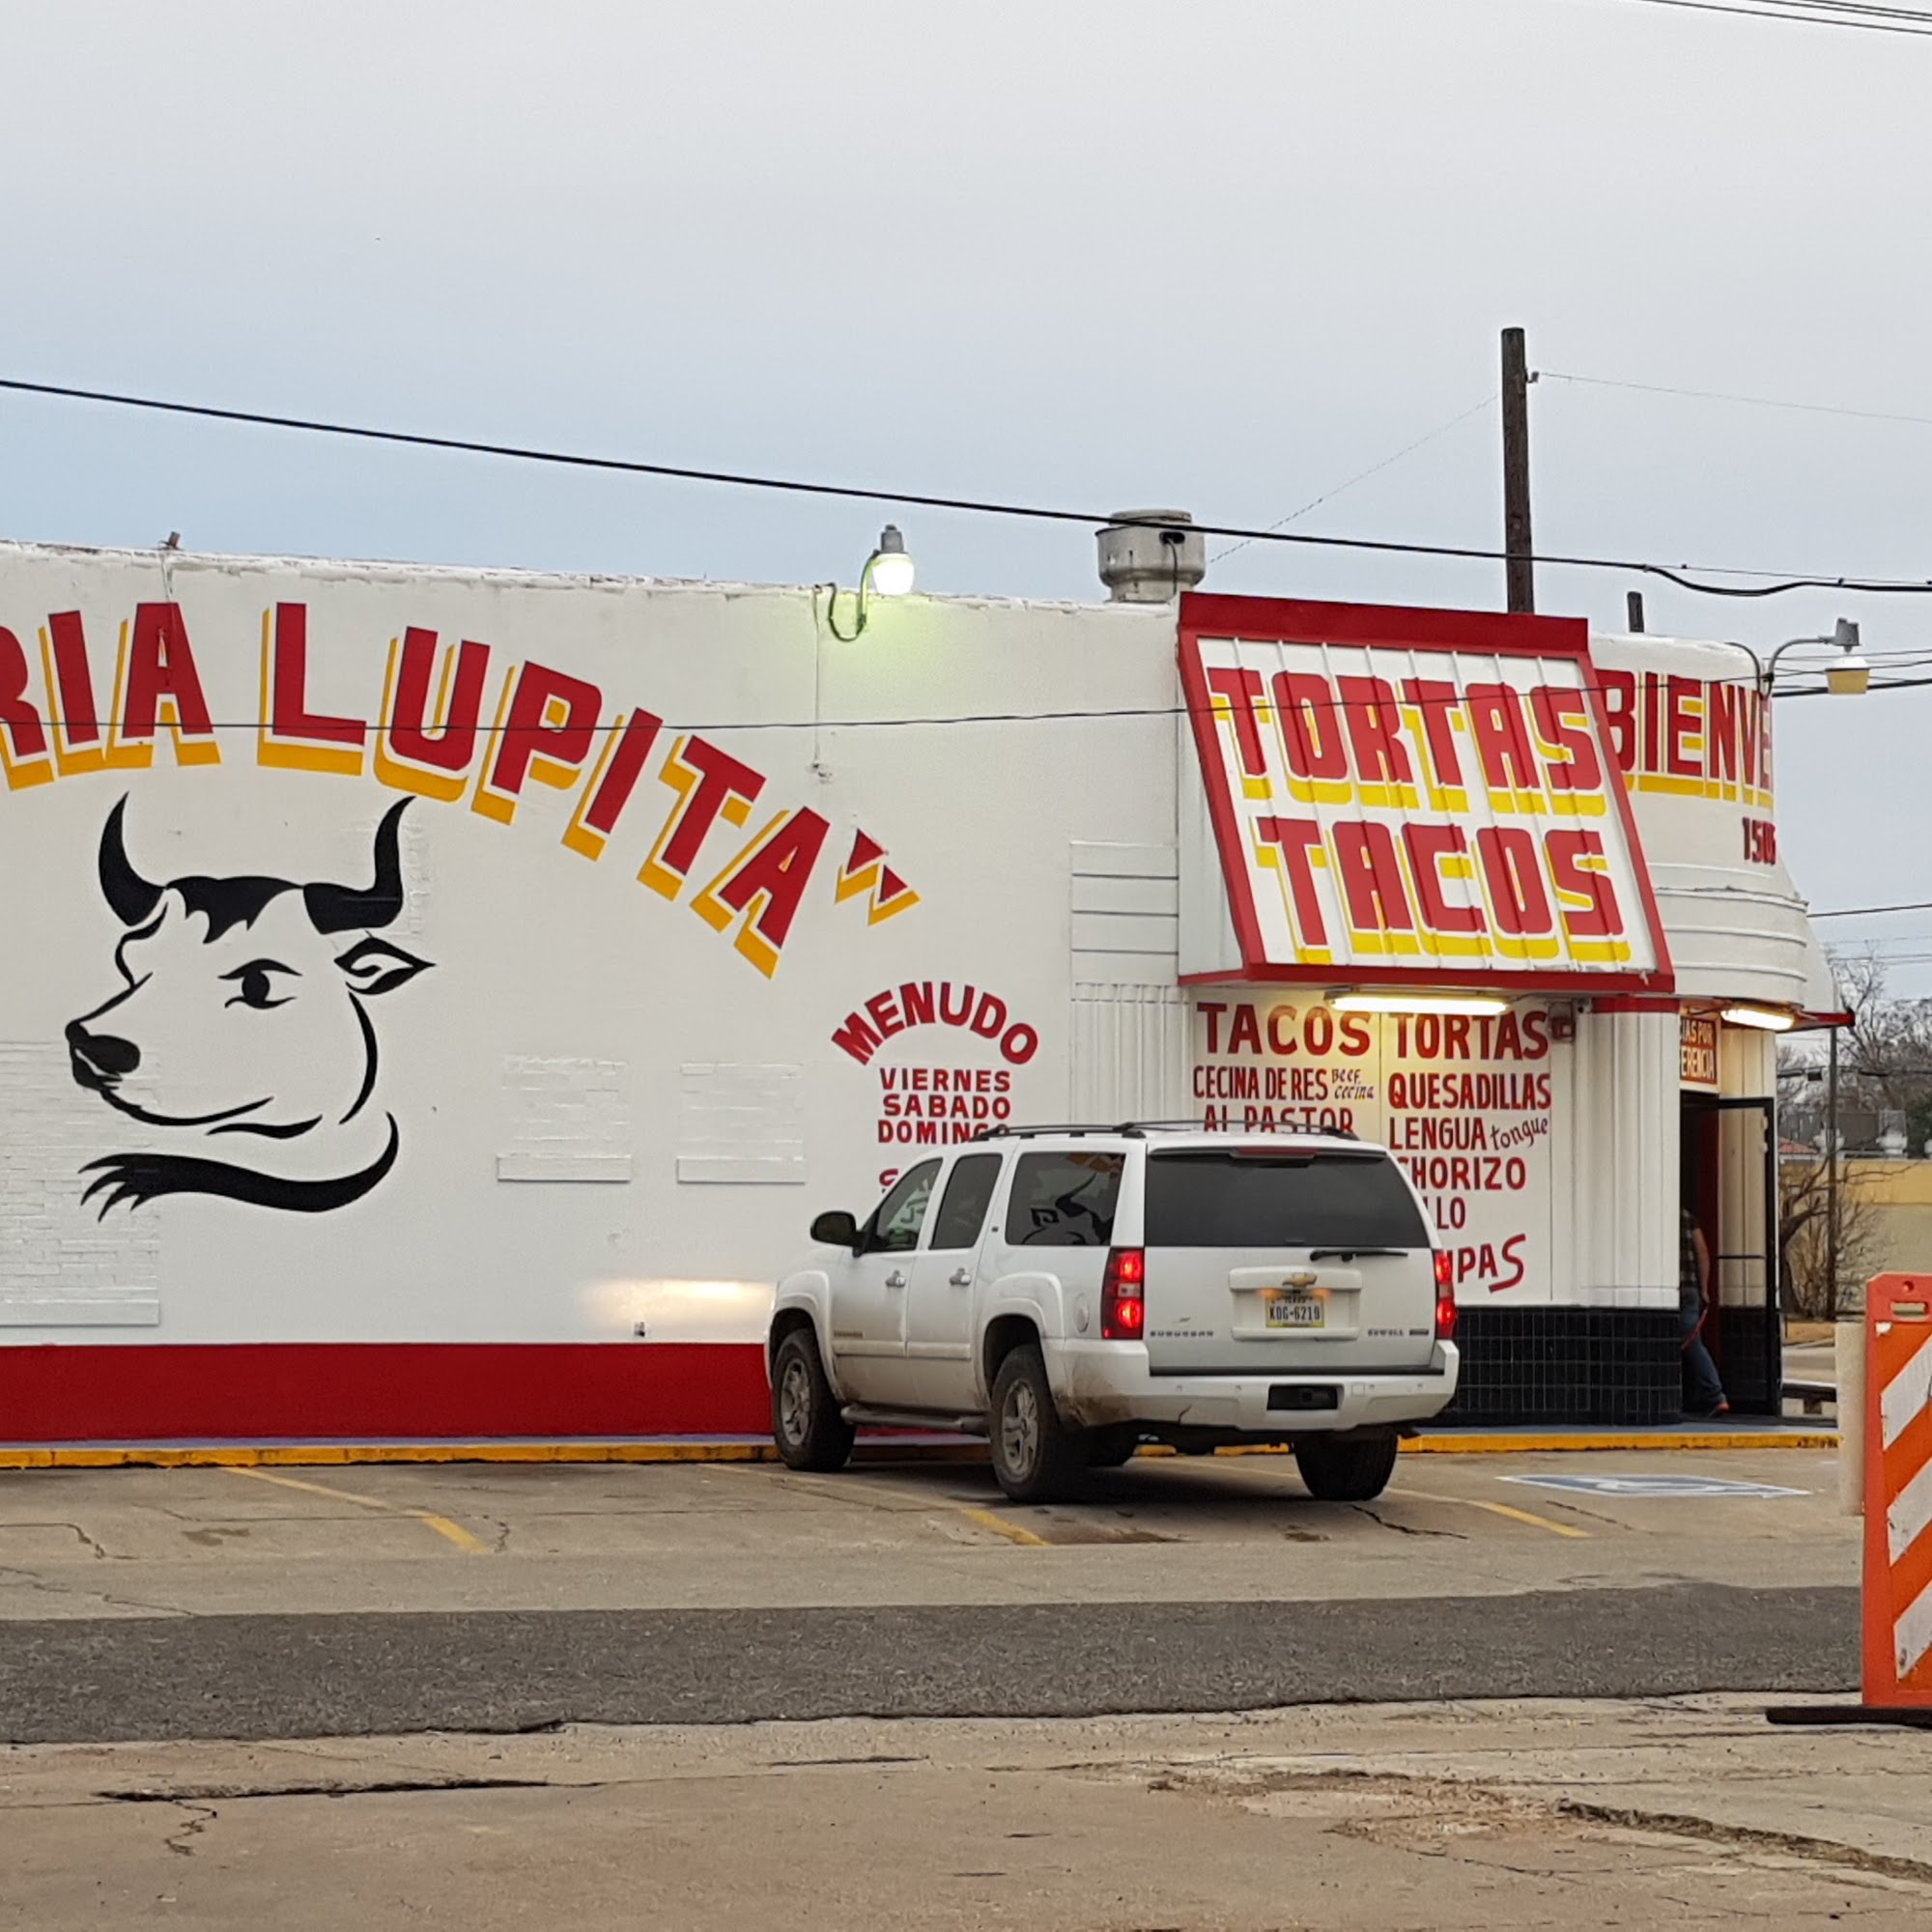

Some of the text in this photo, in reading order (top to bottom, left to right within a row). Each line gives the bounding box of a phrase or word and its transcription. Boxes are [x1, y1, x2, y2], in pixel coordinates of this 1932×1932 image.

[1207, 667, 1606, 816] TORTAS
[1249, 816, 1632, 965] TACOS
[831, 981, 1038, 1065] MENUDO
[1196, 1002, 1371, 1057] TACOS
[1388, 1010, 1549, 1061] TORTAS
[879, 1067, 1011, 1093] VIERNES
[1193, 1065, 1260, 1100] CECINA
[1265, 1067, 1287, 1100] DE
[1291, 1068, 1329, 1101] RES
[1388, 1072, 1552, 1110] QUESADILLAS
[883, 1094, 1011, 1120] SABADO
[1389, 1117, 1548, 1151] LENGUA tongue
